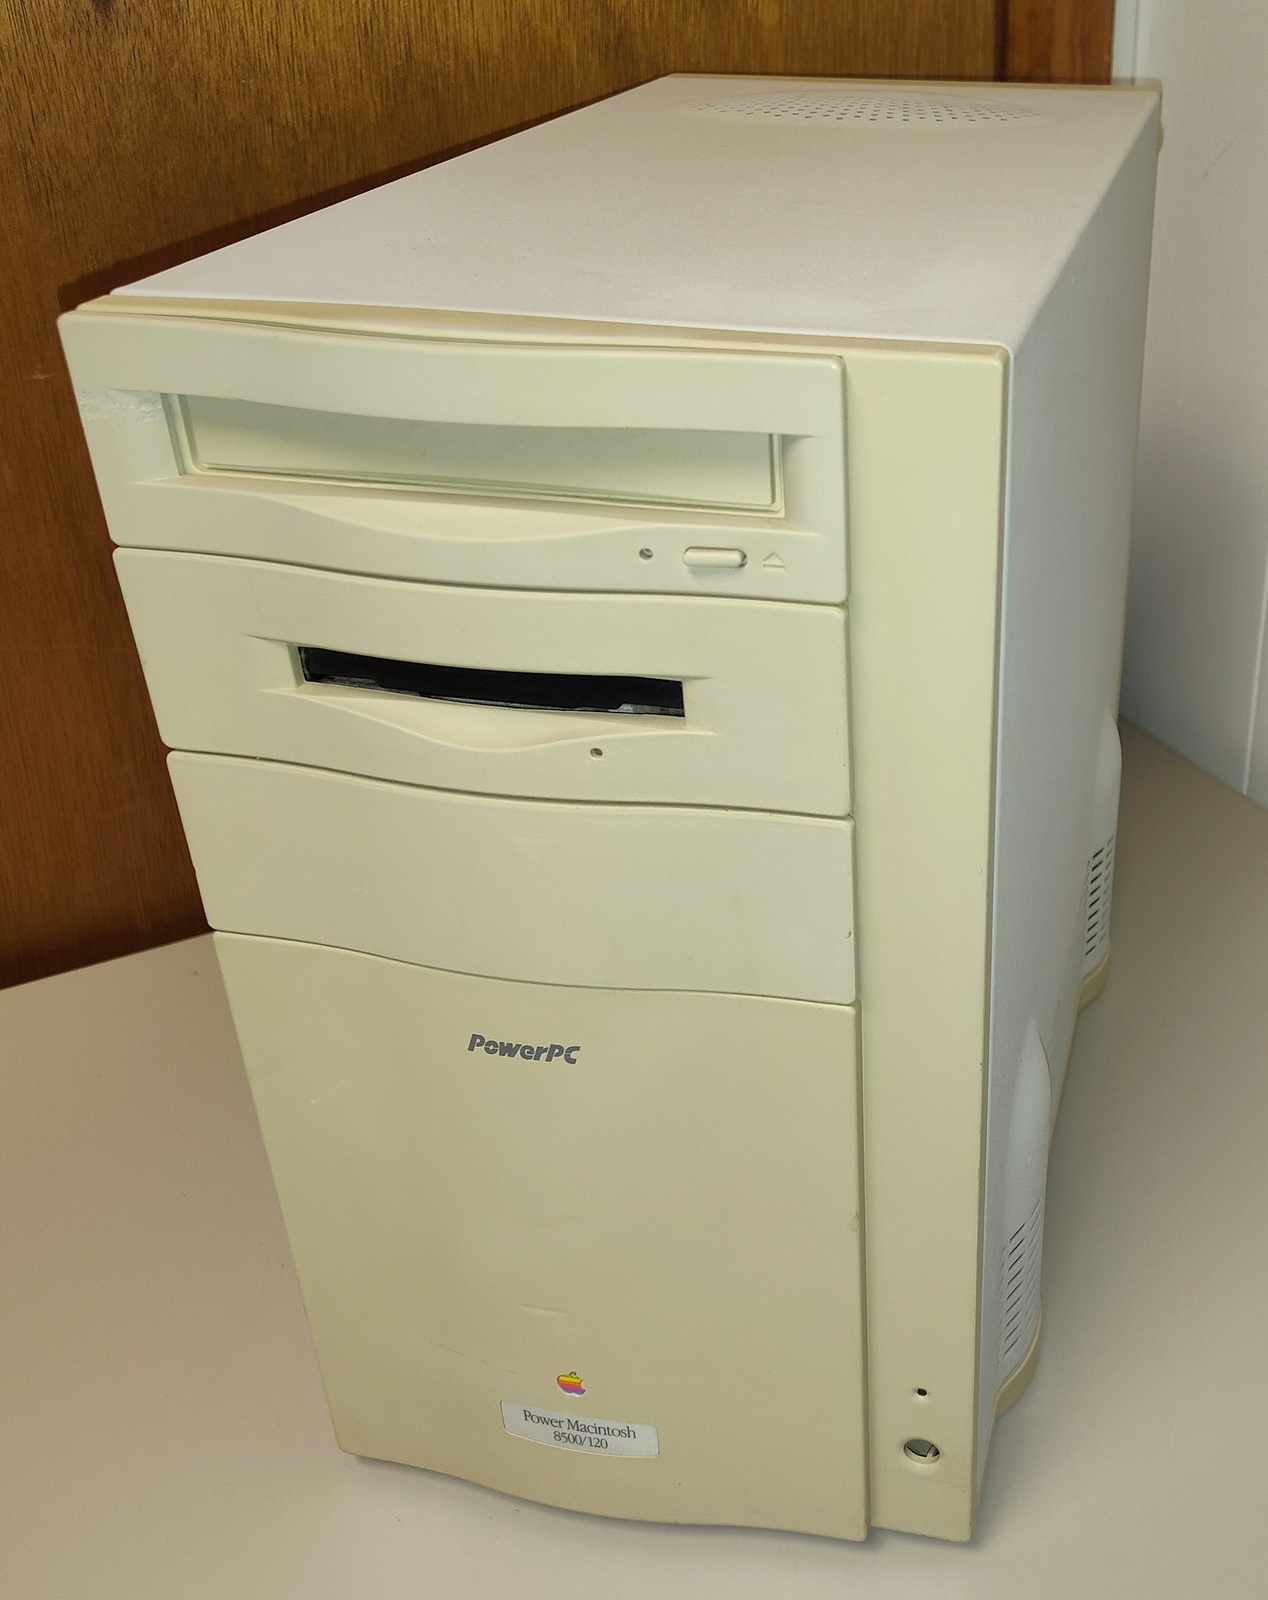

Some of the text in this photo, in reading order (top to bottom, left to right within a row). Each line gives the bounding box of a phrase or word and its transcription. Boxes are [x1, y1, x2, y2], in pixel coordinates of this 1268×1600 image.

[467, 1033, 581, 1065] PowerPC
[522, 1409, 637, 1438] Power Macintosh
[553, 1430, 608, 1449] 8500/120
